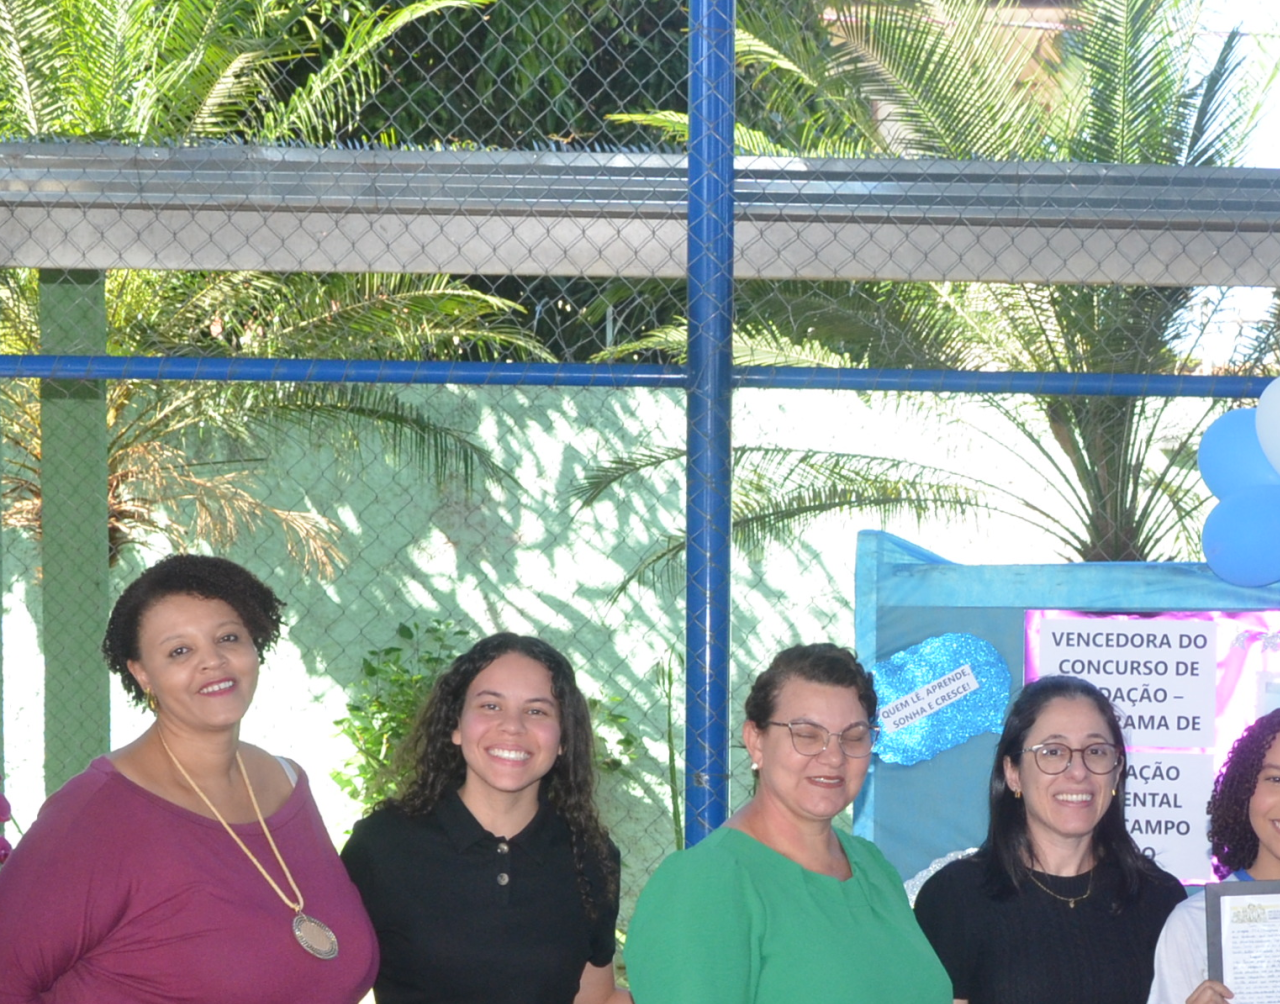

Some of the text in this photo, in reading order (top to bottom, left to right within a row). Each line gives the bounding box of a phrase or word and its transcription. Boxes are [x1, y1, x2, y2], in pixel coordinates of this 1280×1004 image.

[1051, 631, 1208, 650] VENCEDORA DO
[1058, 658, 1200, 677] CONCURSO DE
[1098, 683, 1168, 706] DAÇÃO
[881, 699, 910, 719] QUEM
[892, 682, 972, 729] SONHA E CRESCE!
[1176, 716, 1202, 731] DE
[1125, 819, 1191, 836] AMPO
